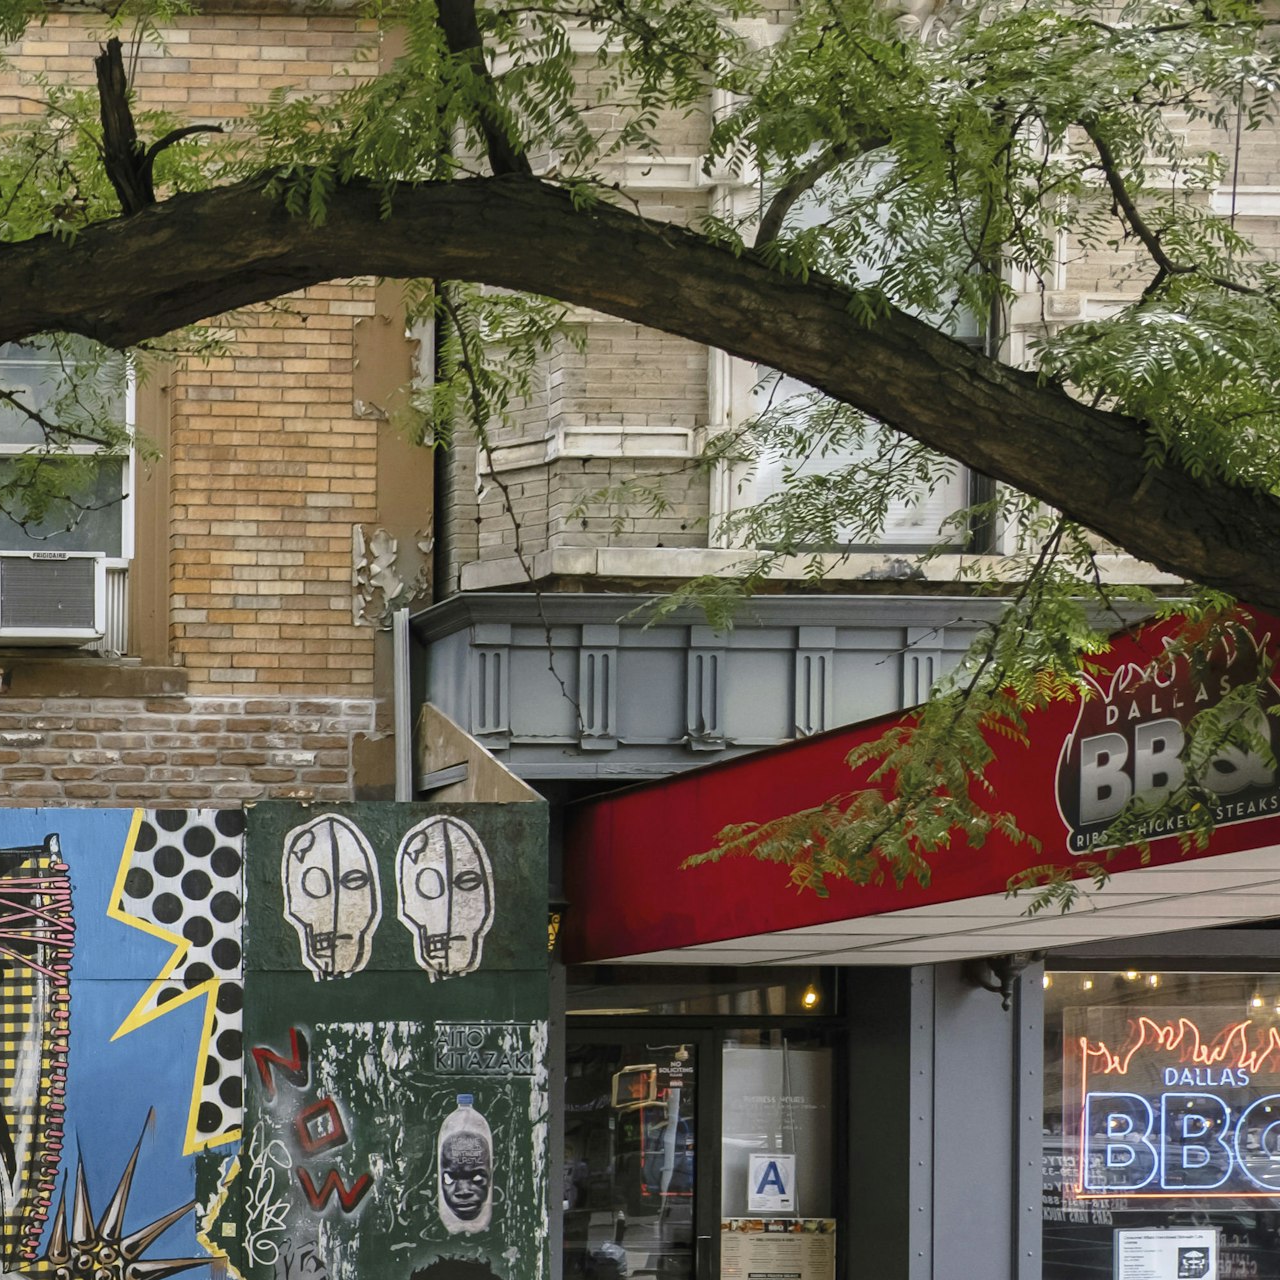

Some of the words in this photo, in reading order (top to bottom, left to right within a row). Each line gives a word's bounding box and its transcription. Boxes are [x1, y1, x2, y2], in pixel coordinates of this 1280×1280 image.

[1106, 675, 1231, 726] DALLAS
[1128, 814, 1193, 842] HICKE
[1216, 795, 1279, 821] STEAKS
[435, 1028, 484, 1048] AITO
[435, 1052, 534, 1070] KITAZAKI
[1164, 1067, 1250, 1087] DALLAS
[755, 1160, 787, 1195] A
